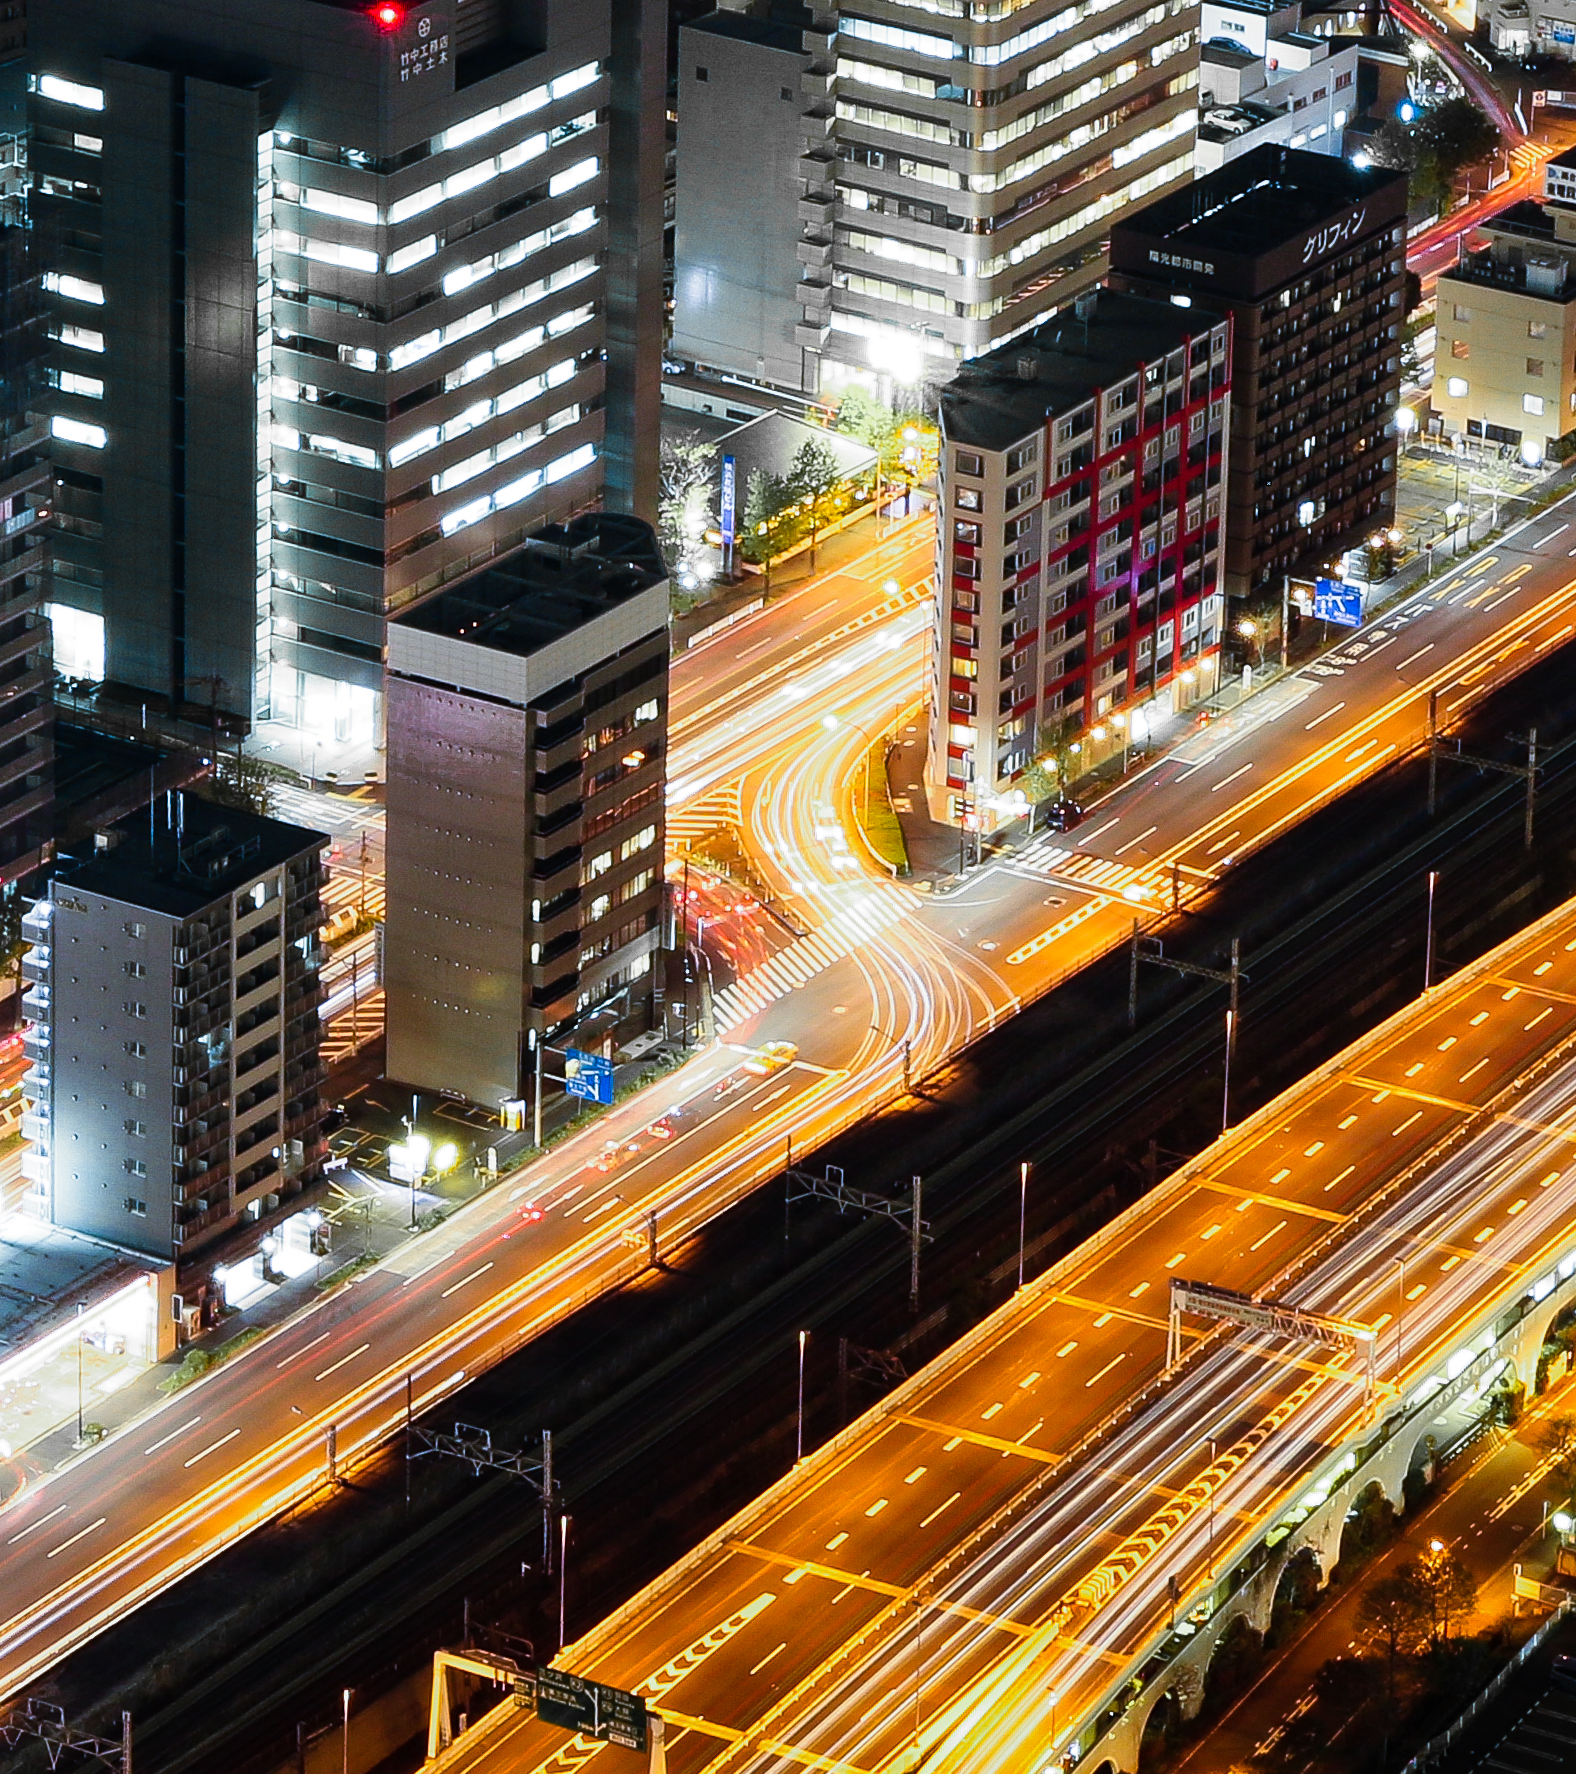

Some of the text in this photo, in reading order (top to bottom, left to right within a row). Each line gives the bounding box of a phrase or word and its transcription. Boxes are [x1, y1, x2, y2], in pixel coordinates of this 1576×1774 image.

[400, 34, 449, 67] 竹中工務店
[400, 51, 449, 82] 竹中土木
[1302, 208, 1366, 264] グリフィン
